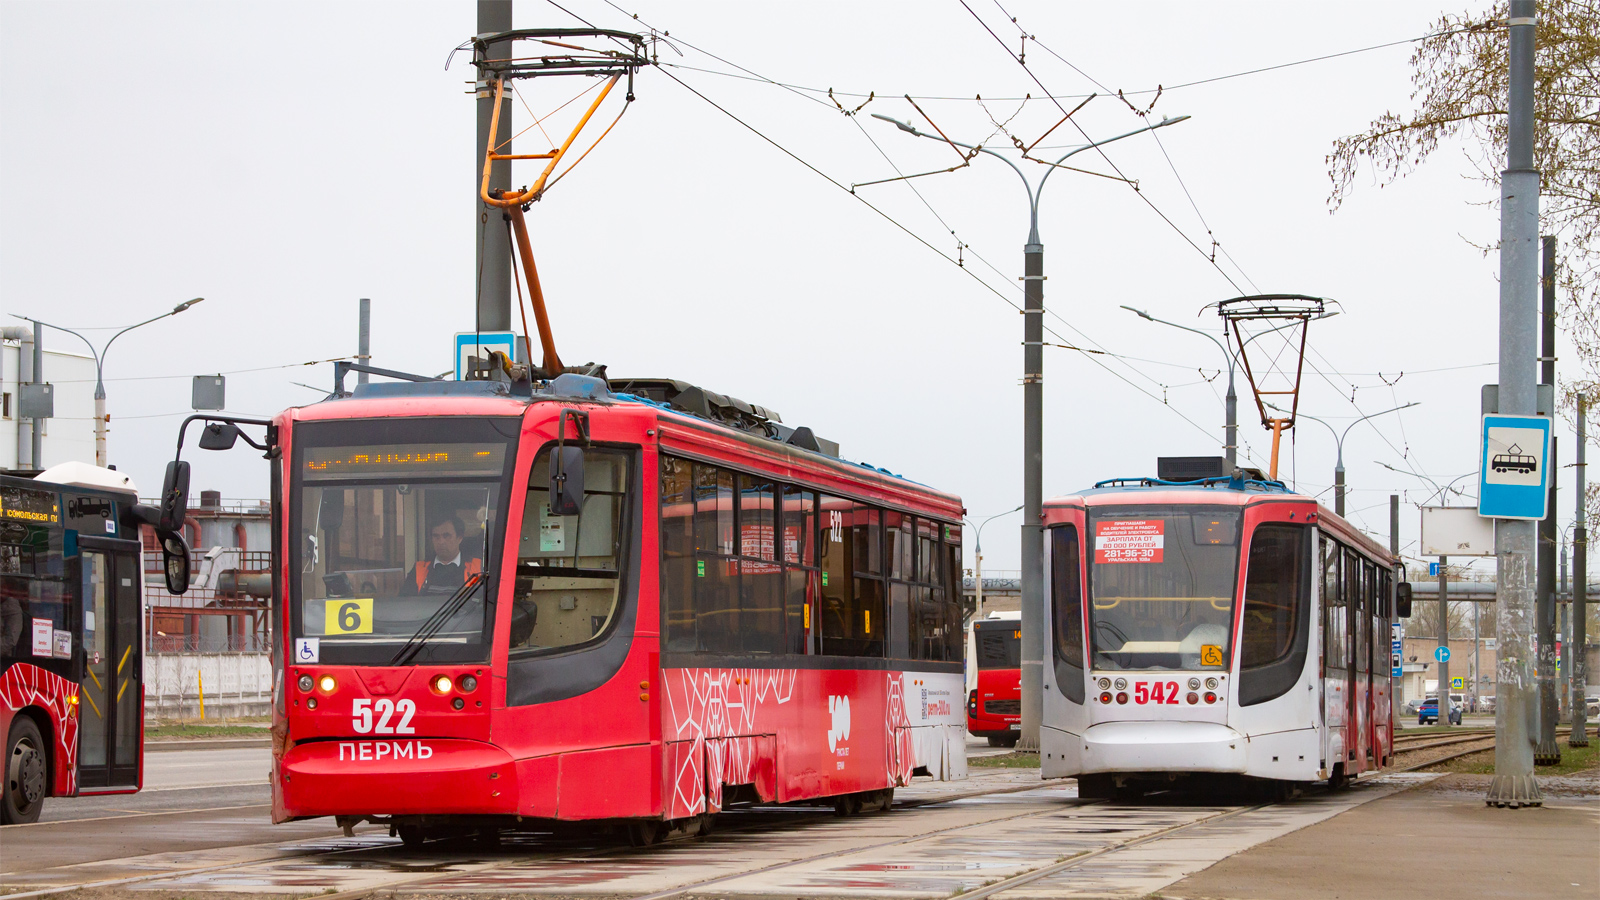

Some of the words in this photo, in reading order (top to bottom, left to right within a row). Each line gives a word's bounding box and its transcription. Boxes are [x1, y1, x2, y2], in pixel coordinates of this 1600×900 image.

[830, 510, 842, 543] 522
[1104, 549, 1154, 557] 281-96-30
[337, 602, 362, 632] 6
[1134, 681, 1180, 705] 542
[352, 698, 417, 735] 522
[339, 741, 434, 761] ПЕРМЬ
